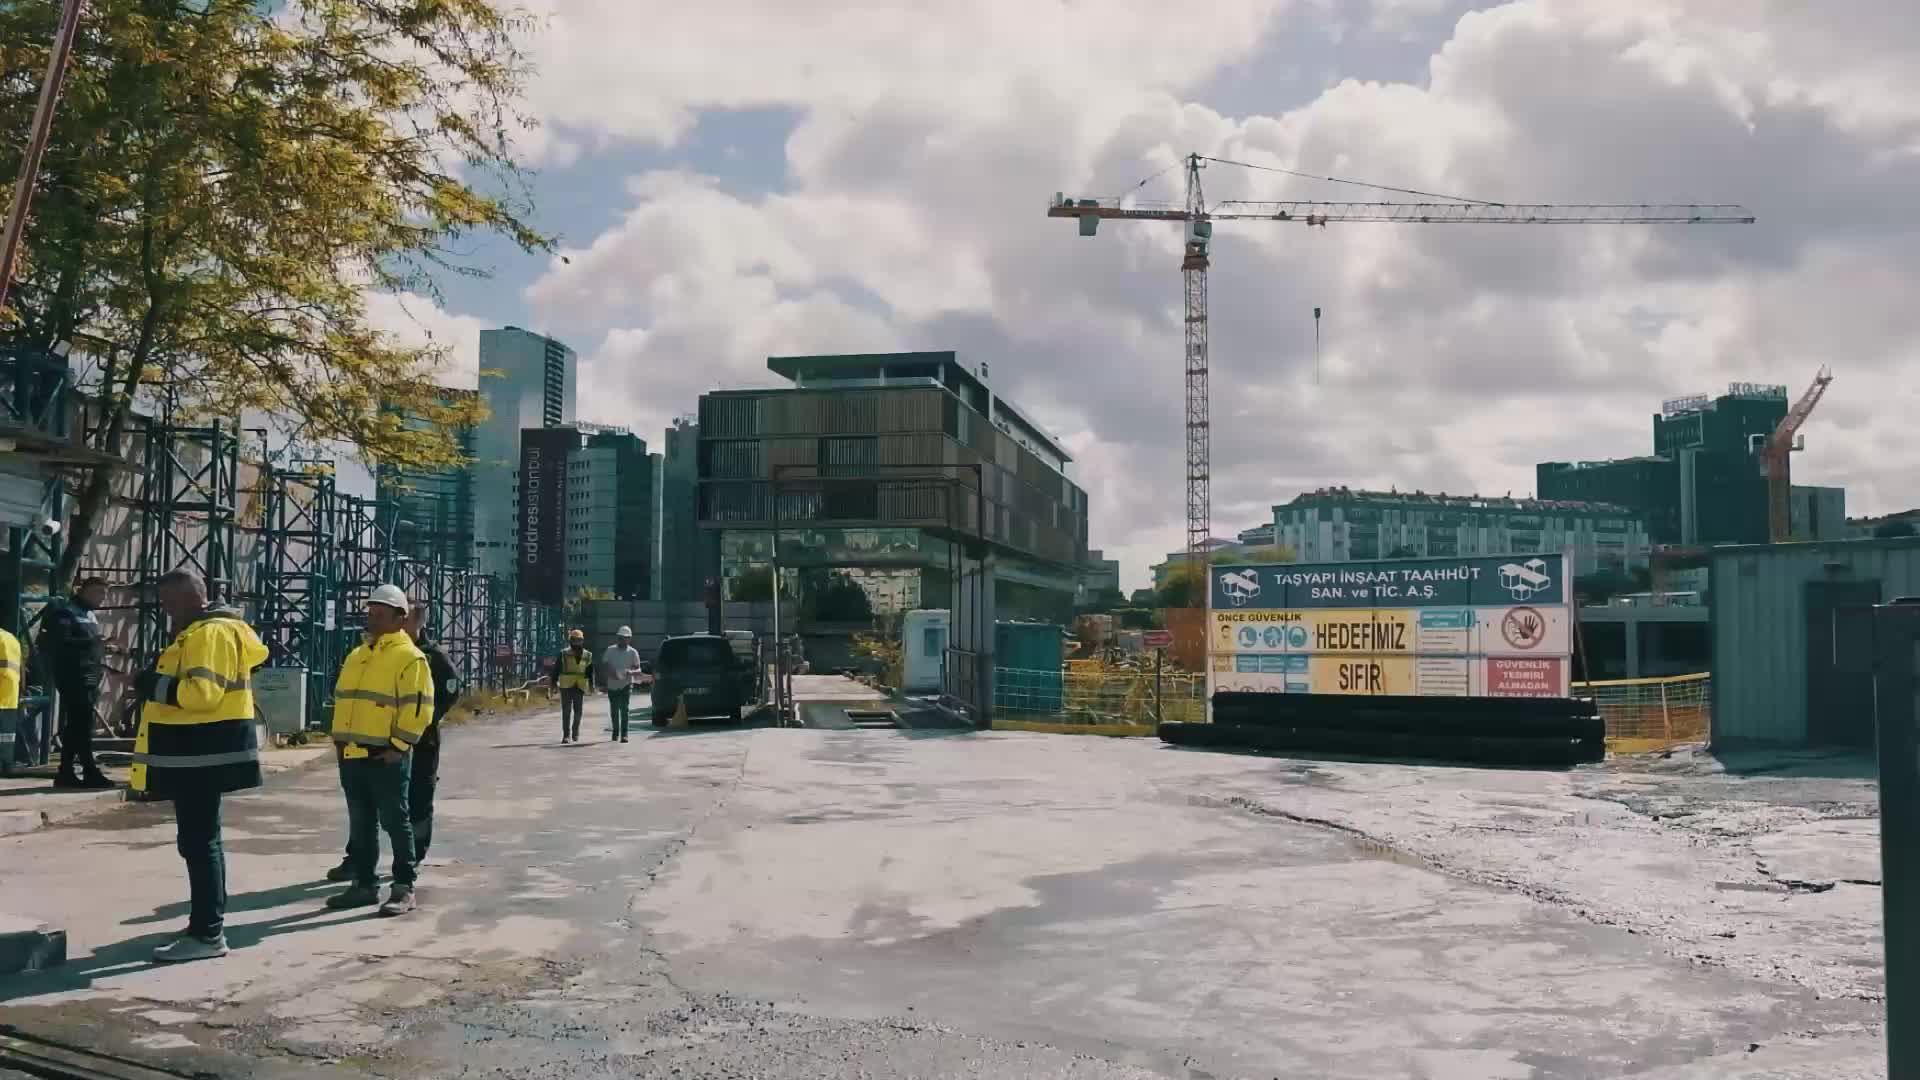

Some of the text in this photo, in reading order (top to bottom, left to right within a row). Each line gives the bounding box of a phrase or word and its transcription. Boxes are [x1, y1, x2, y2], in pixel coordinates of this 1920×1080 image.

[1275, 566, 1481, 586] TAŞYAPI İNŞAAT TAAHHÜT
[1311, 585, 1438, 599] SAN. ve TİC. A.Ş.
[1217, 612, 1302, 622] ÖNCE GÜVENLİK
[1317, 616, 1405, 650] HEDEFİMİZ
[1339, 663, 1381, 691] SIFIR
